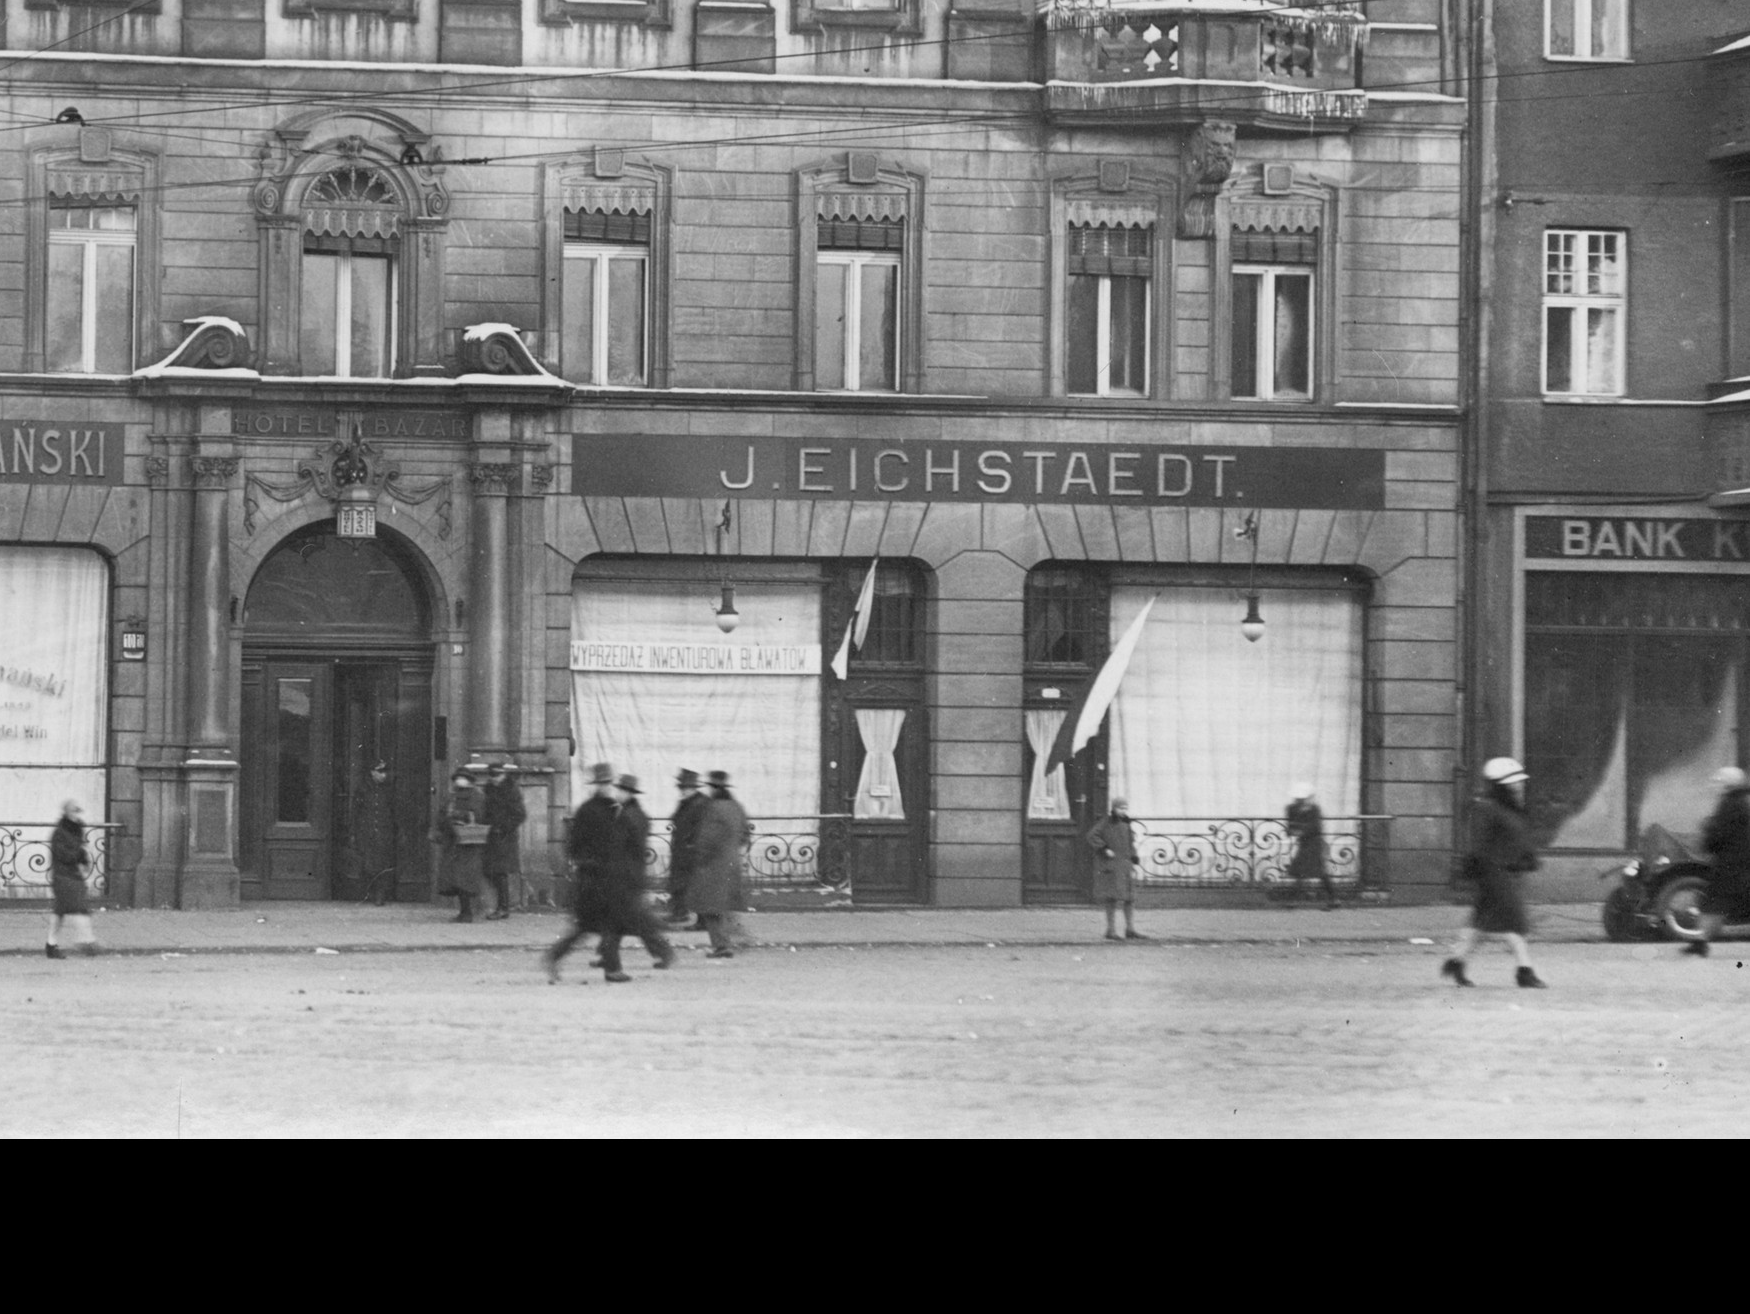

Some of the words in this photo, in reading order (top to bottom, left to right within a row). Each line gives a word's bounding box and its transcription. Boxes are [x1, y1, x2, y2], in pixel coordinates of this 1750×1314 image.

[373, 417, 467, 437] BAZAR
[720, 446, 780, 491] J.
[798, 447, 1245, 498] EICHSTAEDT.
[1562, 519, 1686, 557] BANK
[650, 646, 734, 670] INWENTUROWA
[24, 725, 48, 740] Win
